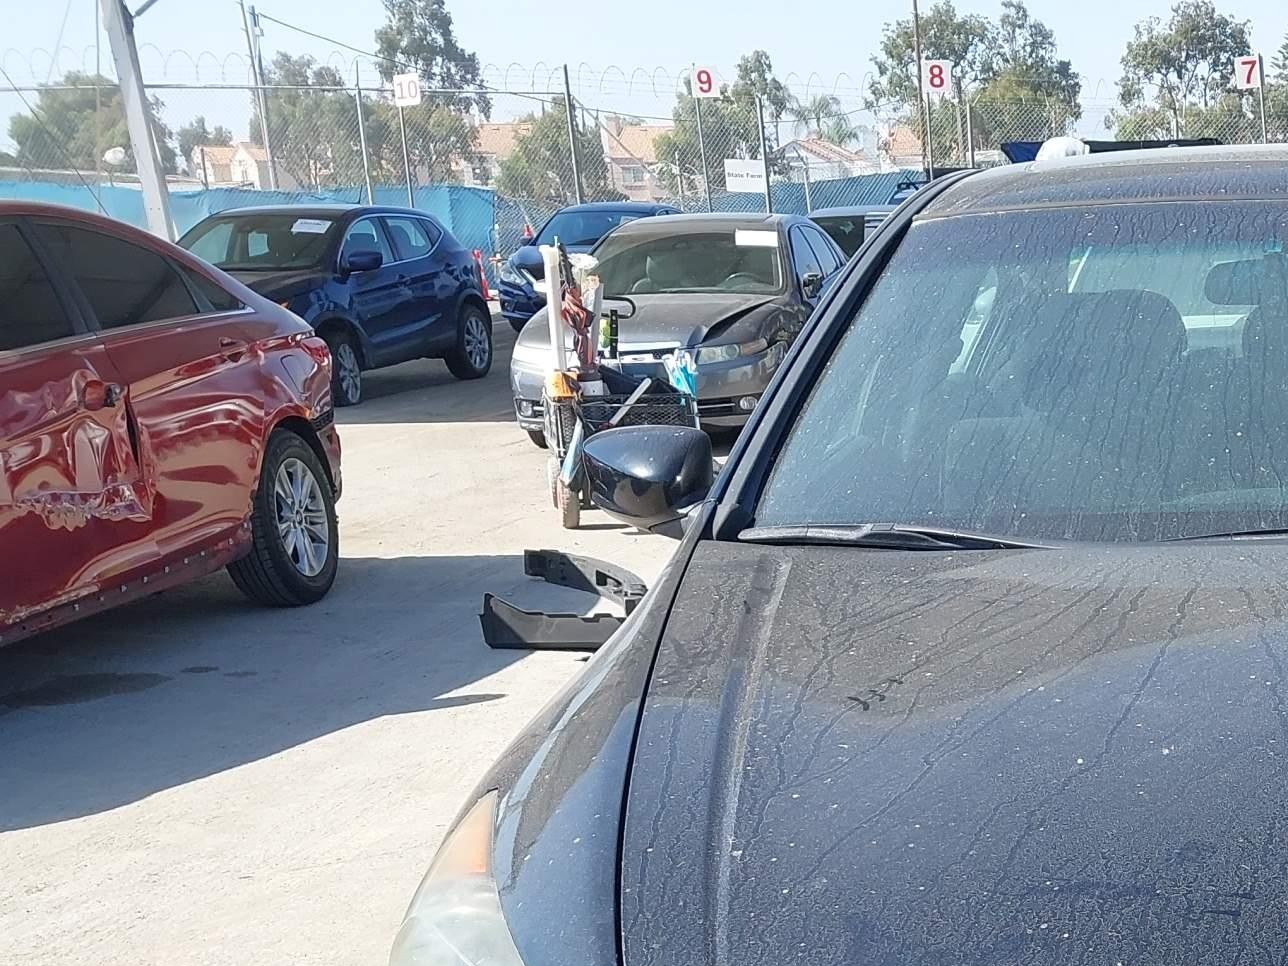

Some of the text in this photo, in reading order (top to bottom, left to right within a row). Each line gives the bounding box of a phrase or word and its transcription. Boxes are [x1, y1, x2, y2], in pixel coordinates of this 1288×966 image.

[697, 70, 712, 93] 9
[929, 65, 944, 88] 8
[1241, 60, 1256, 84] 7
[397, 80, 417, 99] 10
